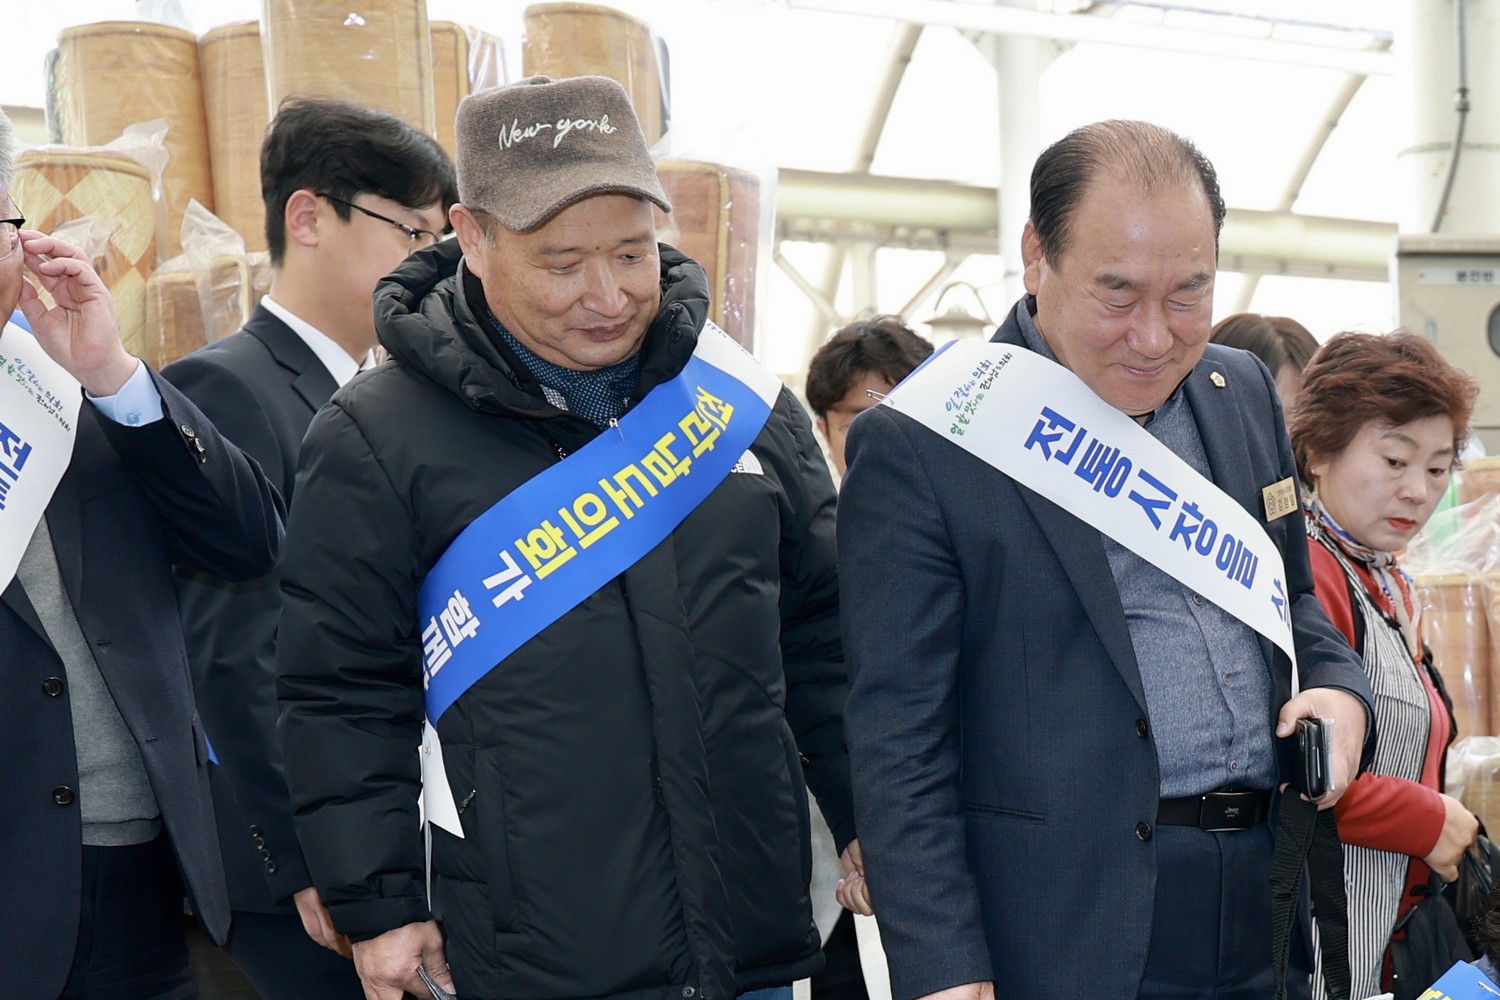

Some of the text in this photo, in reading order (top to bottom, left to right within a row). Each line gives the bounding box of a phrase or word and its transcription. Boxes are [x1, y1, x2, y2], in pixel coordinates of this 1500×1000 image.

[498, 118, 552, 150] New
[972, 359, 993, 379] 의회
[482, 385, 734, 608] 전라남도의회가
[1023, 406, 1259, 590] 전통시장을
